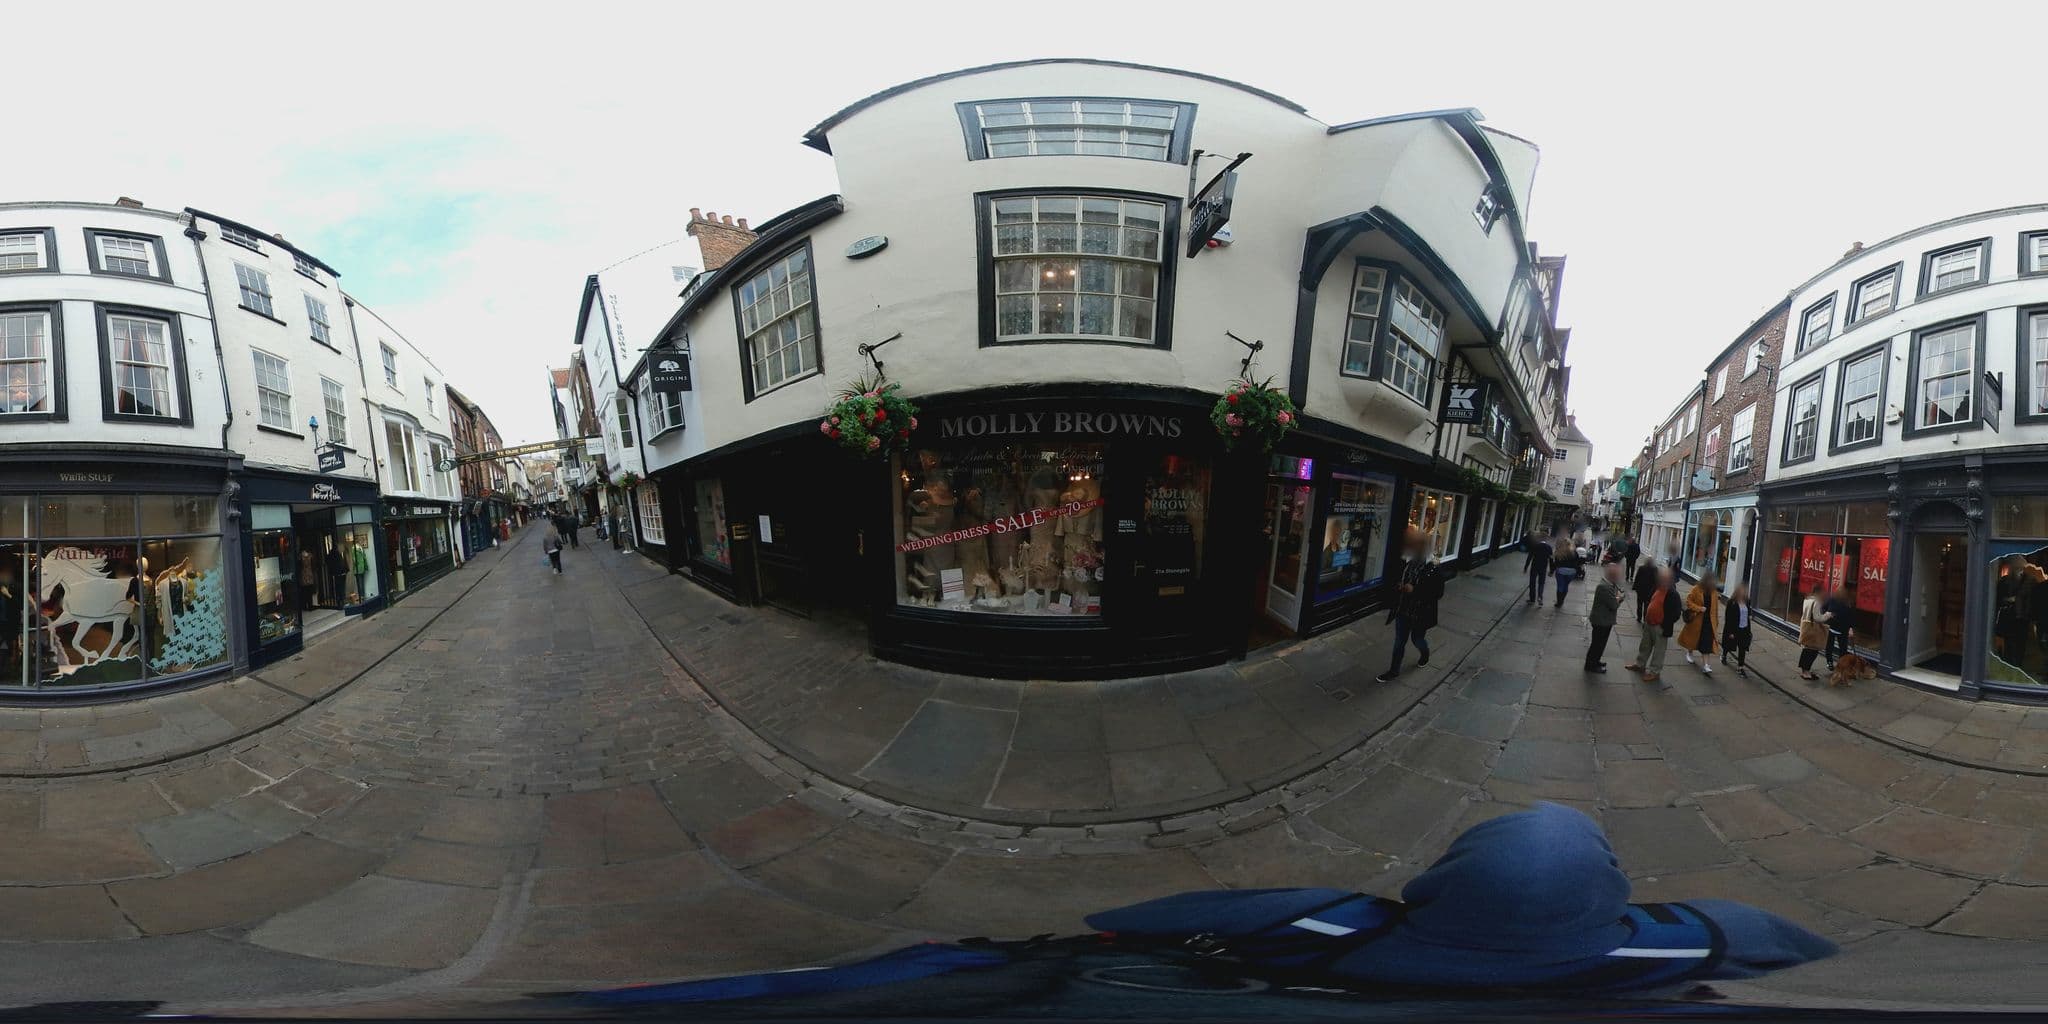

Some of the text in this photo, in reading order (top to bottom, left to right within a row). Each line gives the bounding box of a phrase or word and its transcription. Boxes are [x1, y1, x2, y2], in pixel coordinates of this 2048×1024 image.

[940, 412, 1181, 439] MOLLY BROWNS
[1152, 487, 1201, 499] MOLLY
[1151, 499, 1205, 511] BROWNS
[901, 533, 952, 553] WEDDING
[953, 525, 990, 542] DRESS
[994, 508, 1046, 534] SALE
[1803, 557, 1825, 572] SALE
[1863, 566, 1887, 582] SAL
